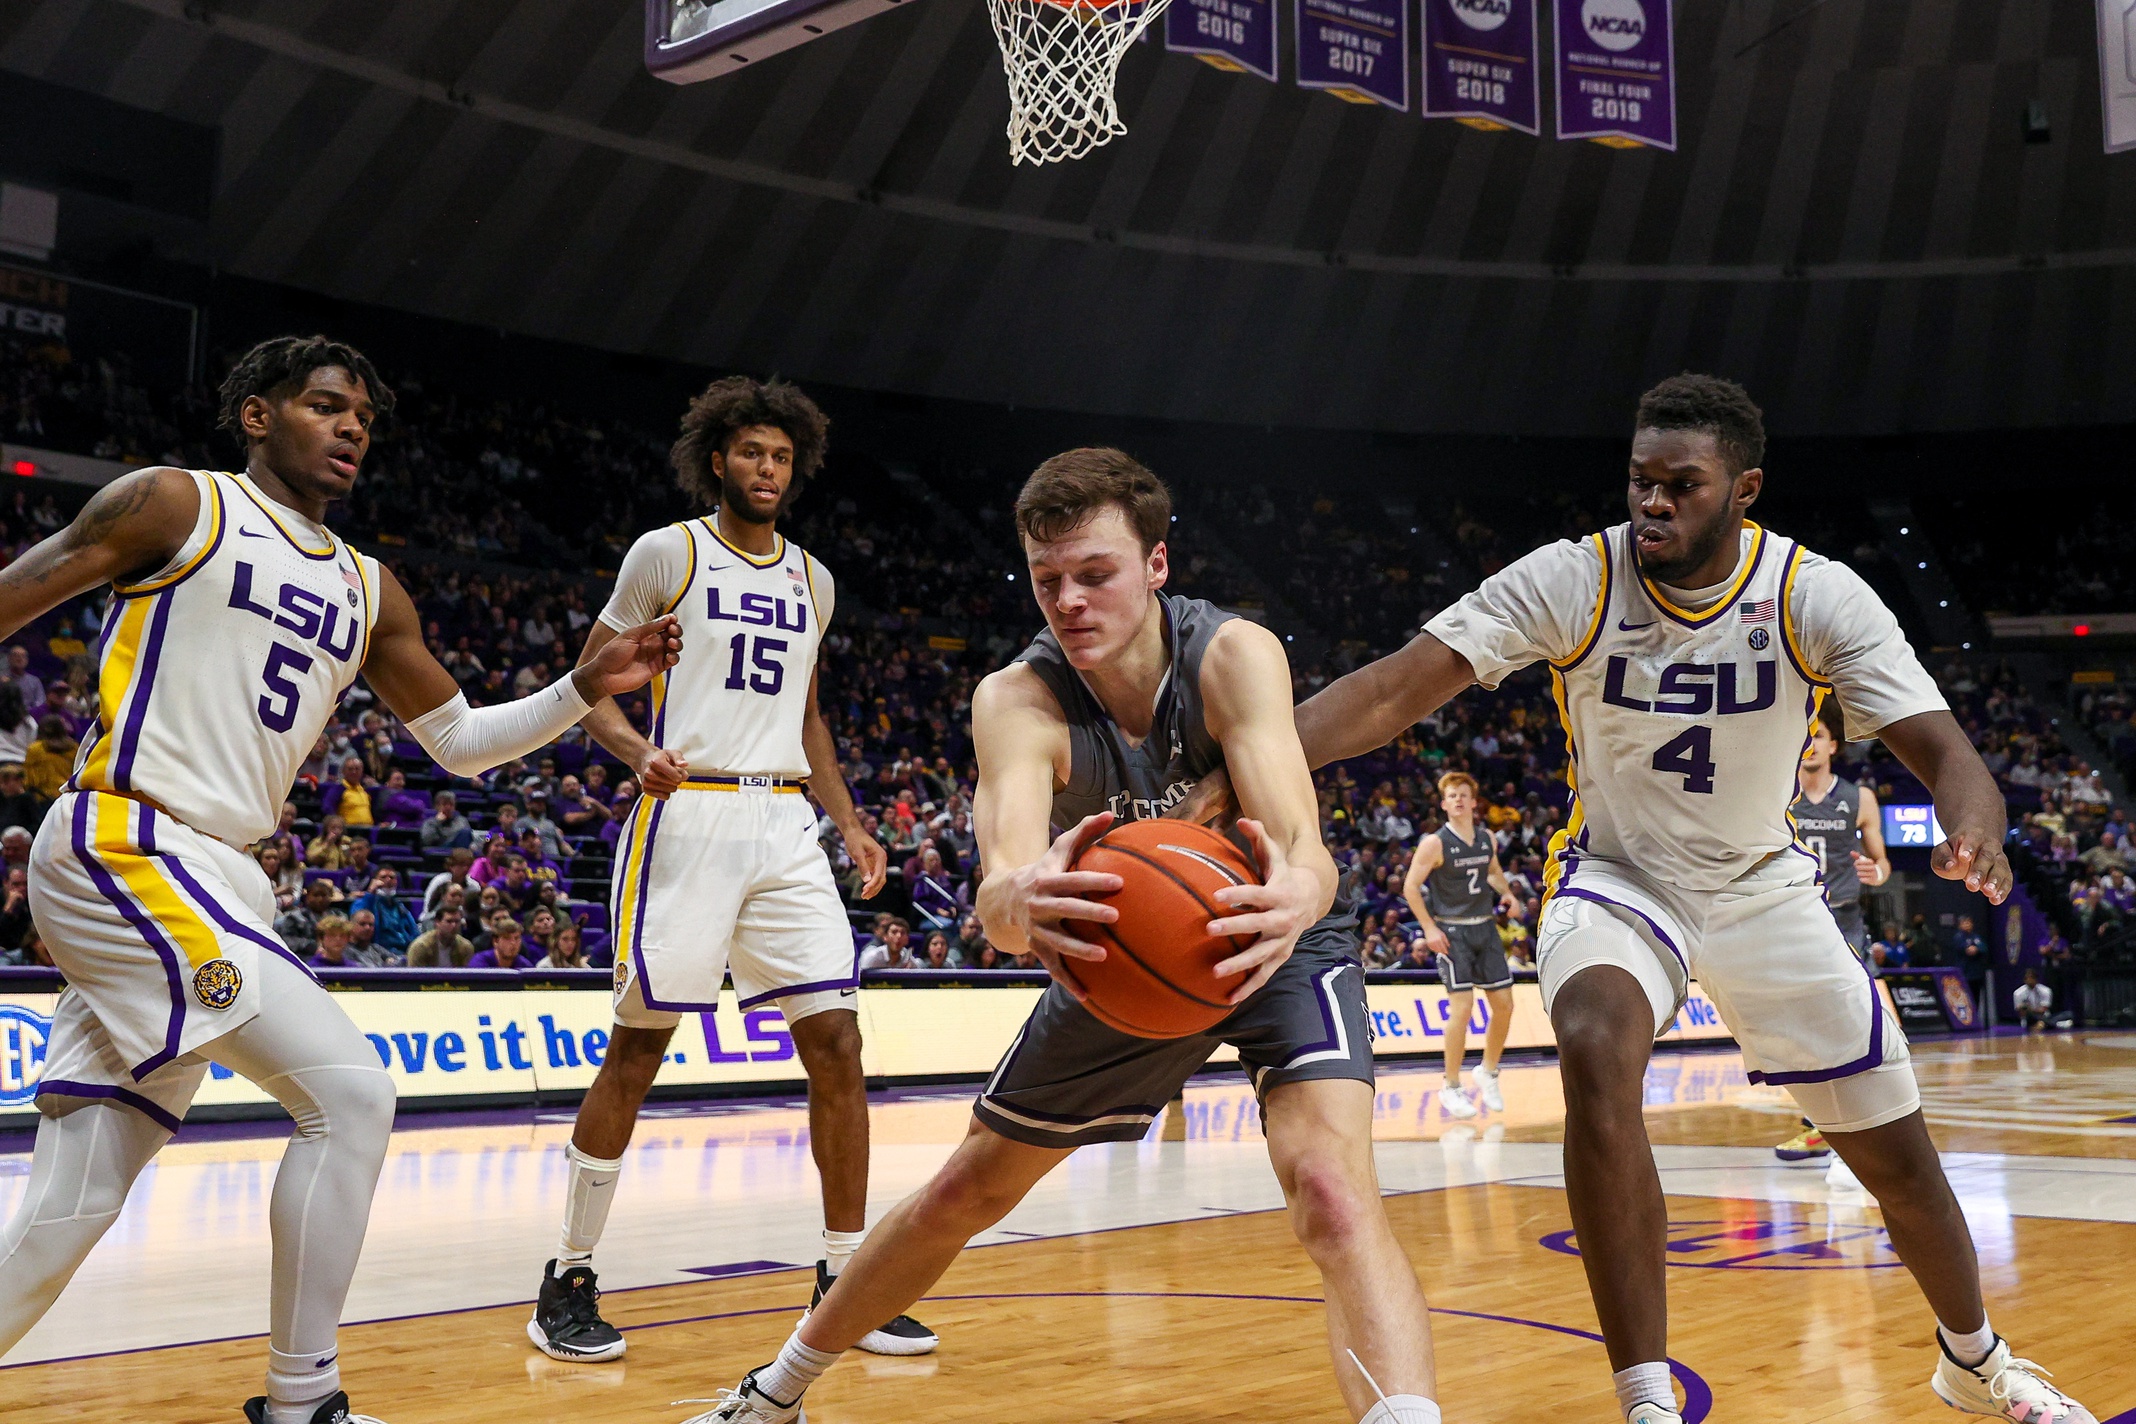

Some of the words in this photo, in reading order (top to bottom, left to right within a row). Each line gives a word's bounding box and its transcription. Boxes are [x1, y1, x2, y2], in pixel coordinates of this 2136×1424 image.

[1197, 10, 1246, 45] 2016
[1319, 26, 1360, 51] SUPER
[1362, 37, 1383, 57] SIX
[1590, 16, 1643, 37] NCAA
[1328, 46, 1375, 77] 2017
[1448, 57, 1489, 78] SUPER
[1491, 64, 1513, 83] SIX
[1456, 76, 1506, 105] 2018
[1579, 79, 1616, 98] FINAL
[1618, 82, 1652, 101] FOUR
[1591, 97, 1641, 122] 2019
[228, 560, 358, 663] LSU
[707, 588, 806, 633] LSU
[1749, 629, 1768, 650] SEC
[725, 633, 788, 696] 15
[258, 641, 314, 734] 5
[1602, 655, 1776, 715] LSU
[1652, 725, 1716, 794] 4
[744, 777, 767, 787] LSU
[1900, 823, 1927, 843] 73
[1466, 868, 1482, 895] 2
[0, 1018, 46, 1091] EC
[478, 1015, 533, 1071] it
